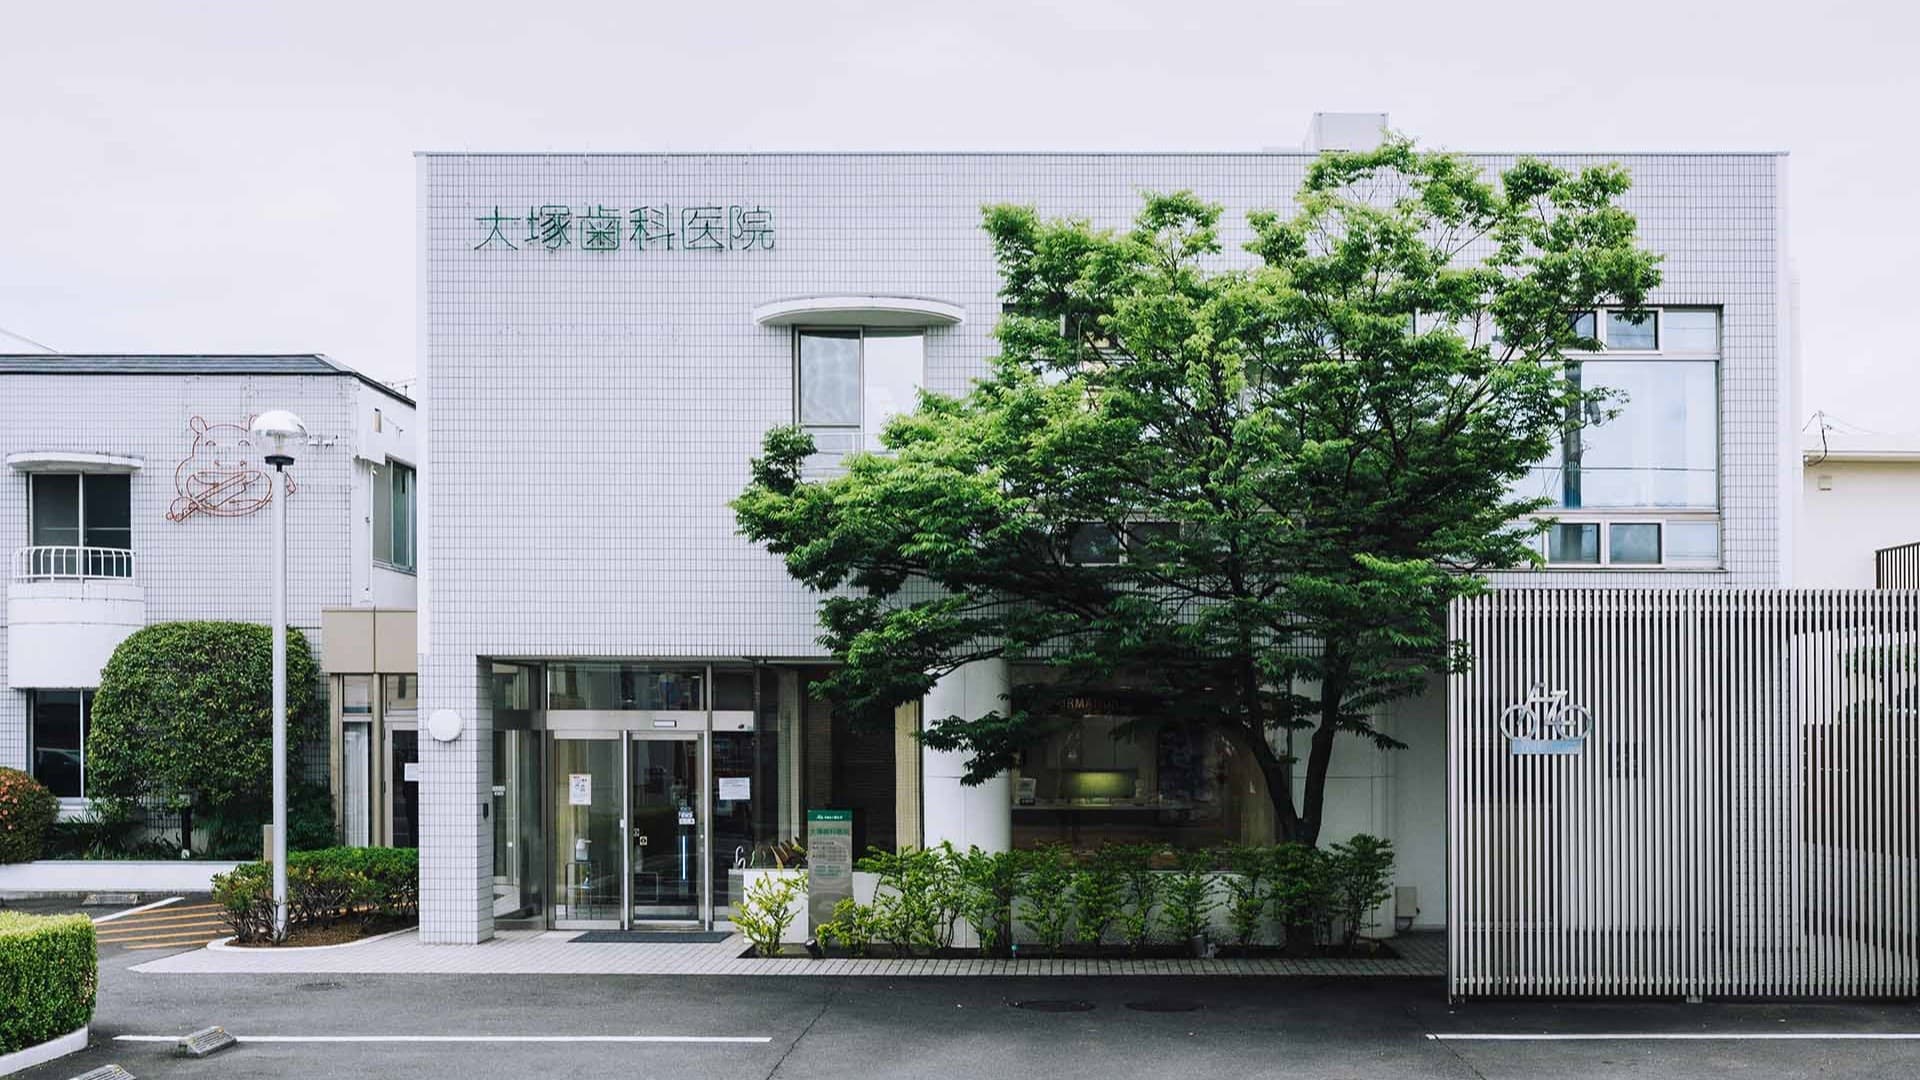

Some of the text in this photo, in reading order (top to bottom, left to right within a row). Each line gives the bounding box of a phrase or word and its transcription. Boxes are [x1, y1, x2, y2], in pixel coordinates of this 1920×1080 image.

[474, 204, 775, 251] 大塚歯科医院
